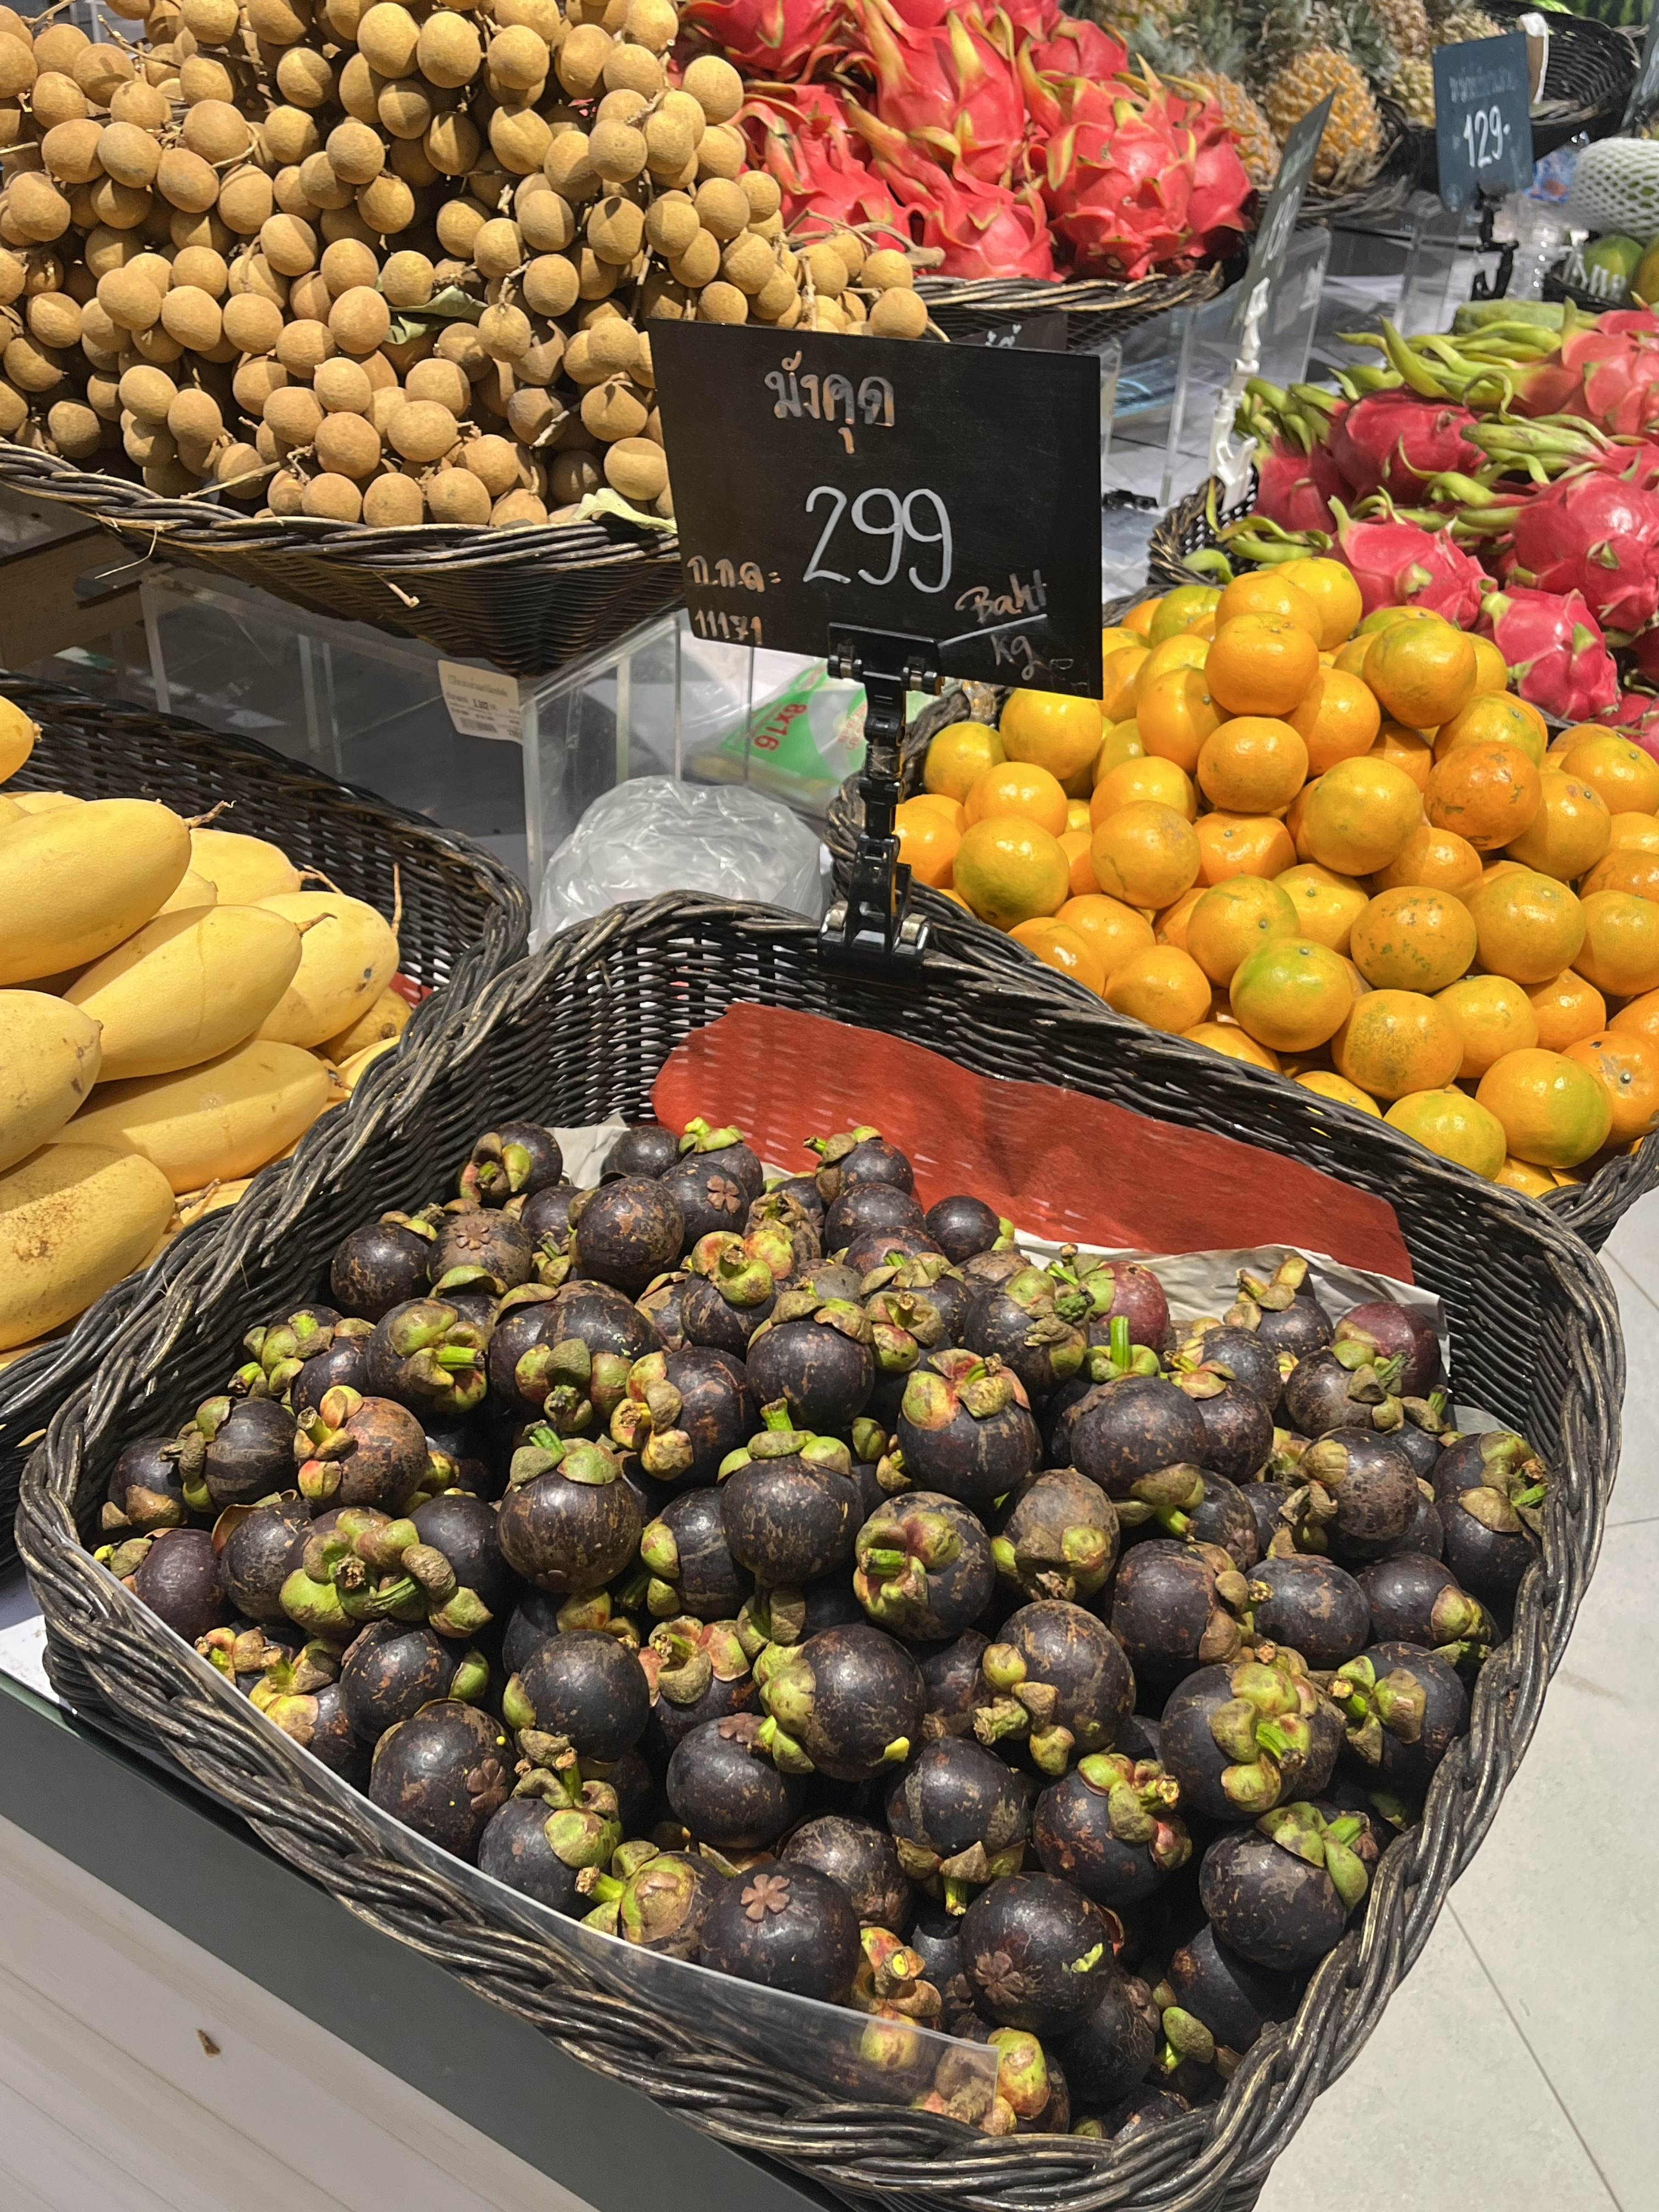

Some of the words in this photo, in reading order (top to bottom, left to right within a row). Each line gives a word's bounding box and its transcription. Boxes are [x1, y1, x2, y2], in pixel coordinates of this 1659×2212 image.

[764, 350, 895, 454] มังคุด
[803, 486, 952, 593] 299
[955, 569, 1047, 624] Baht
